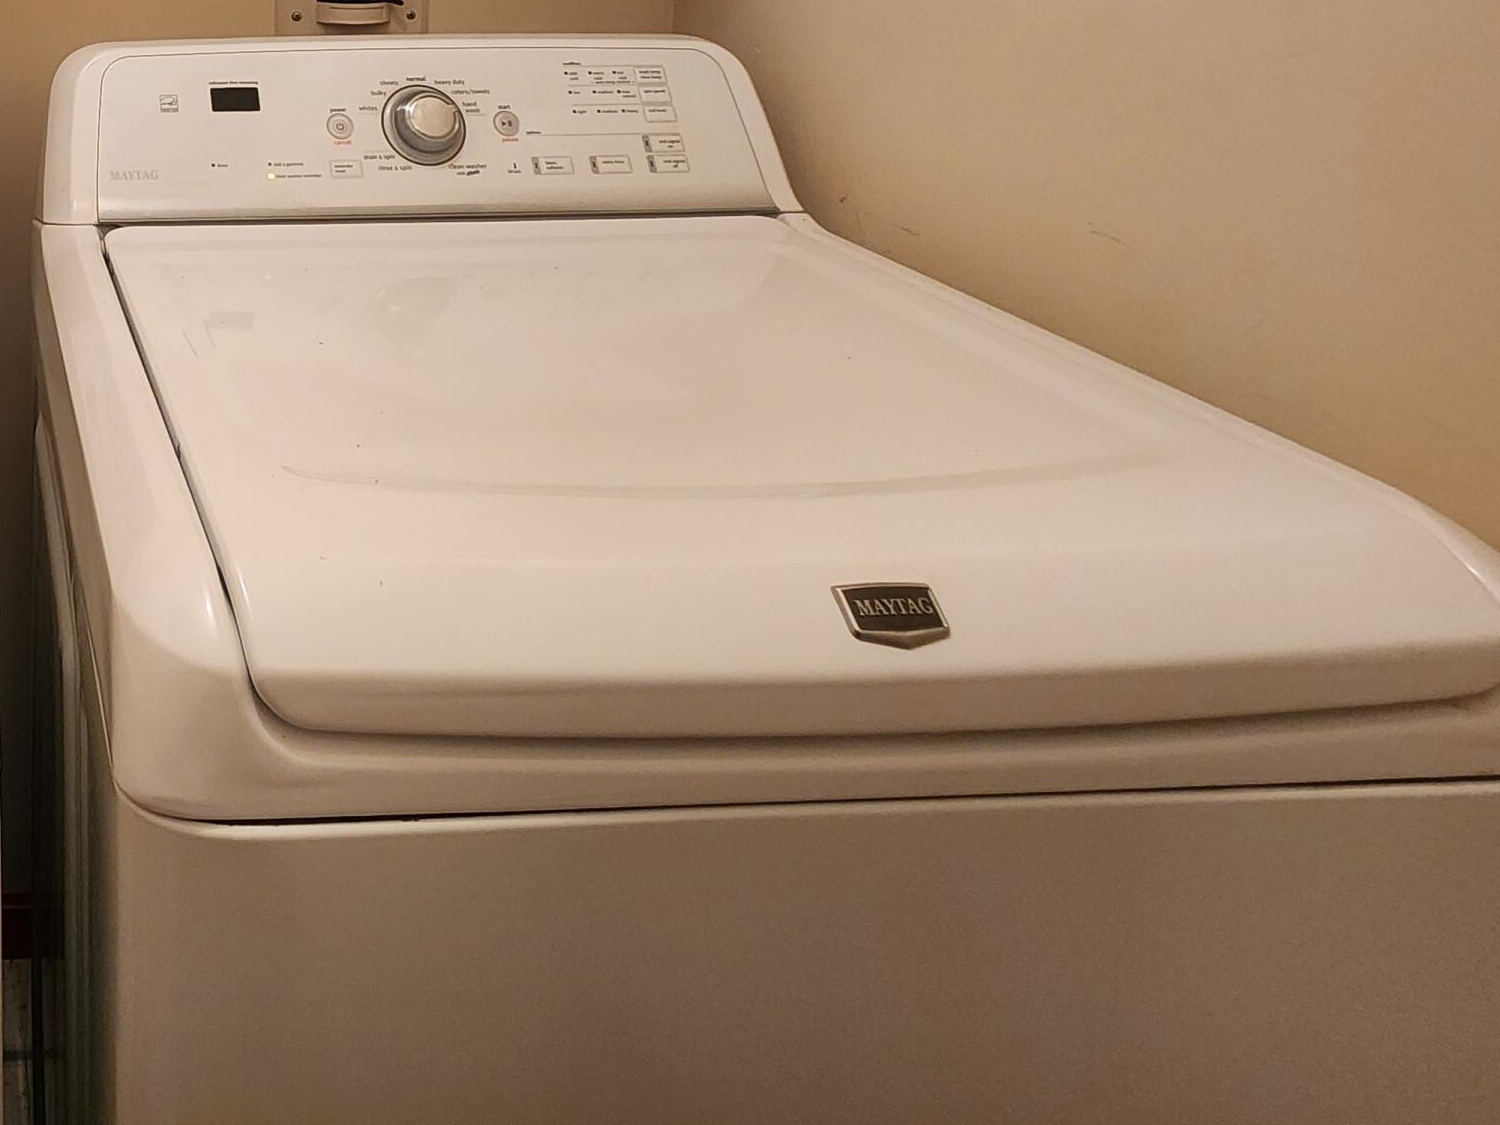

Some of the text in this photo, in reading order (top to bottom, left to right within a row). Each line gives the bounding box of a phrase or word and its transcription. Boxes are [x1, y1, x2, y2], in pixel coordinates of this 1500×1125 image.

[434, 79, 451, 87] heavy
[110, 169, 160, 181] MAYTAG
[852, 597, 934, 616] MAYTAG
